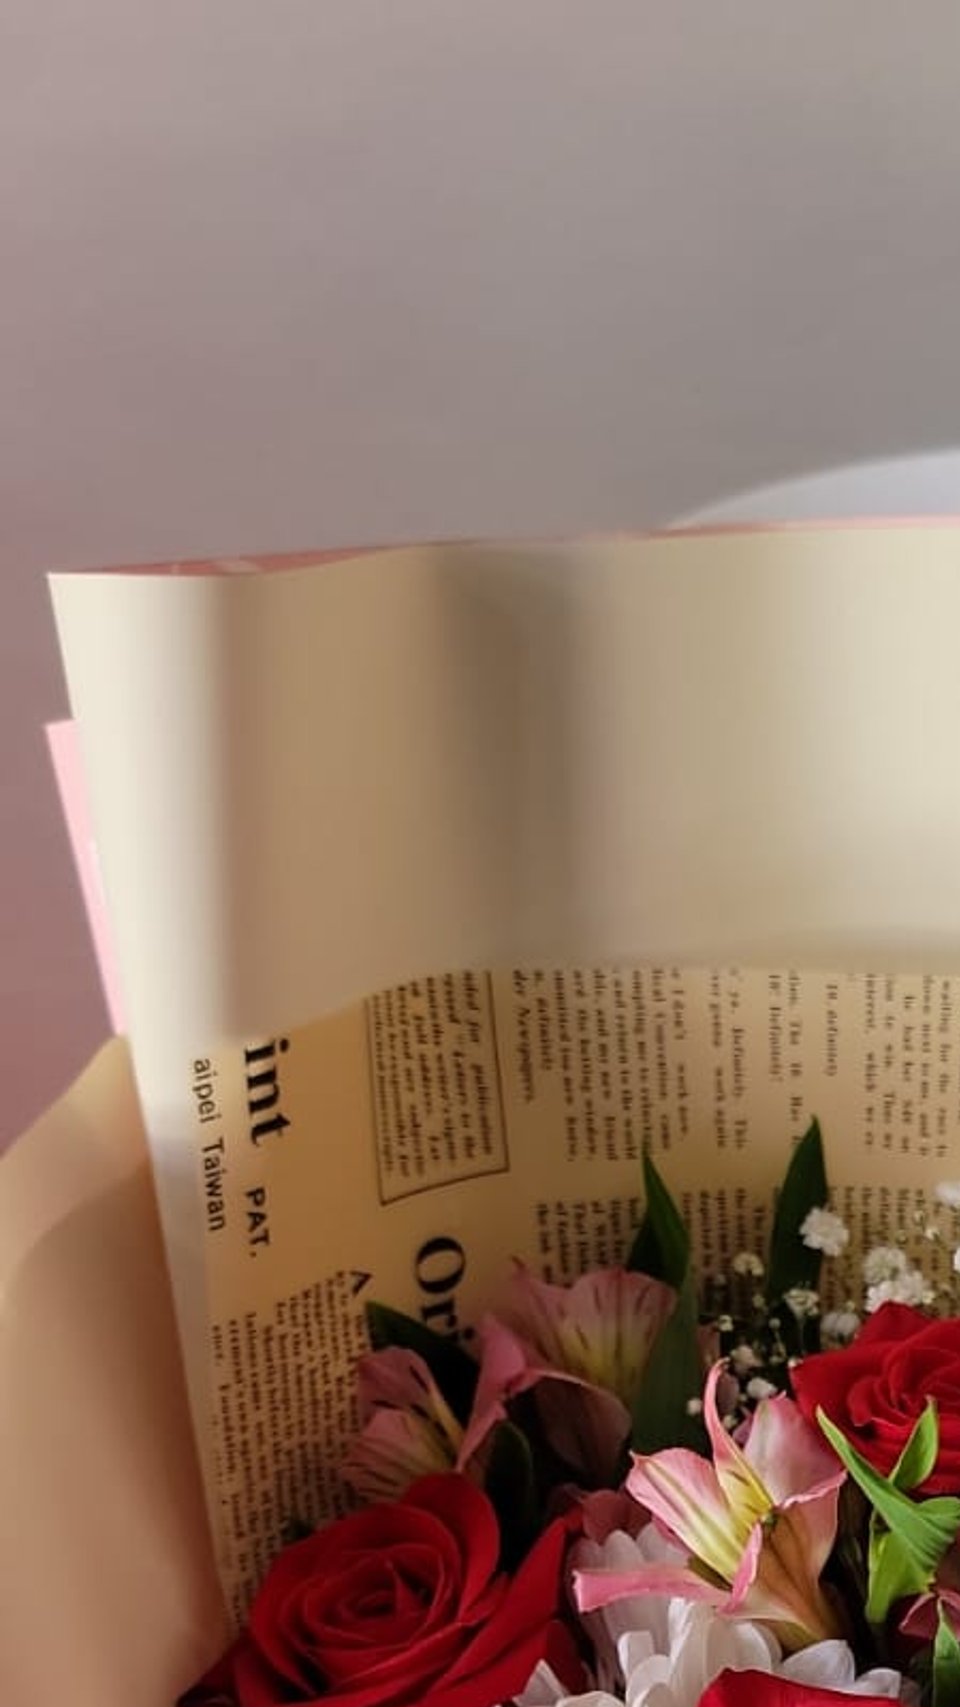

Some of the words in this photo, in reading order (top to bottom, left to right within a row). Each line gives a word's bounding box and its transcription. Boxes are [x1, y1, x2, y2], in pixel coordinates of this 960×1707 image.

[192, 1059, 222, 1124] aipei
[245, 1037, 290, 1147] int
[202, 1138, 227, 1232] Taiwan
[245, 1186, 269, 1258] PAT.
